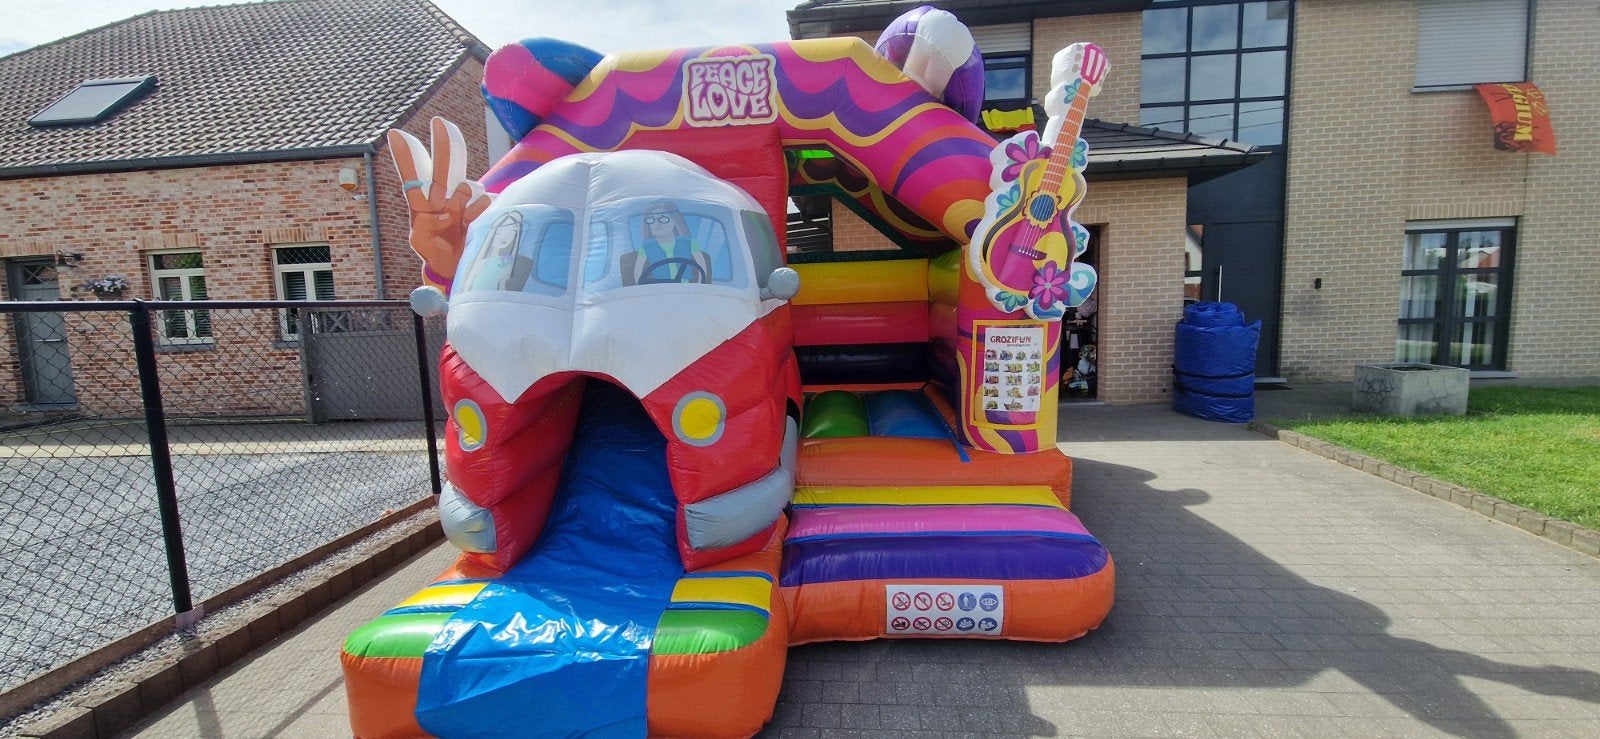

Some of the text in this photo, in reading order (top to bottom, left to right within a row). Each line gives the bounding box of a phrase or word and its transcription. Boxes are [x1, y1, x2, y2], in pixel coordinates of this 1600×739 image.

[691, 60, 769, 94] PEACE
[691, 83, 770, 118] LOVE
[990, 335, 1032, 344] GROZIFUN
